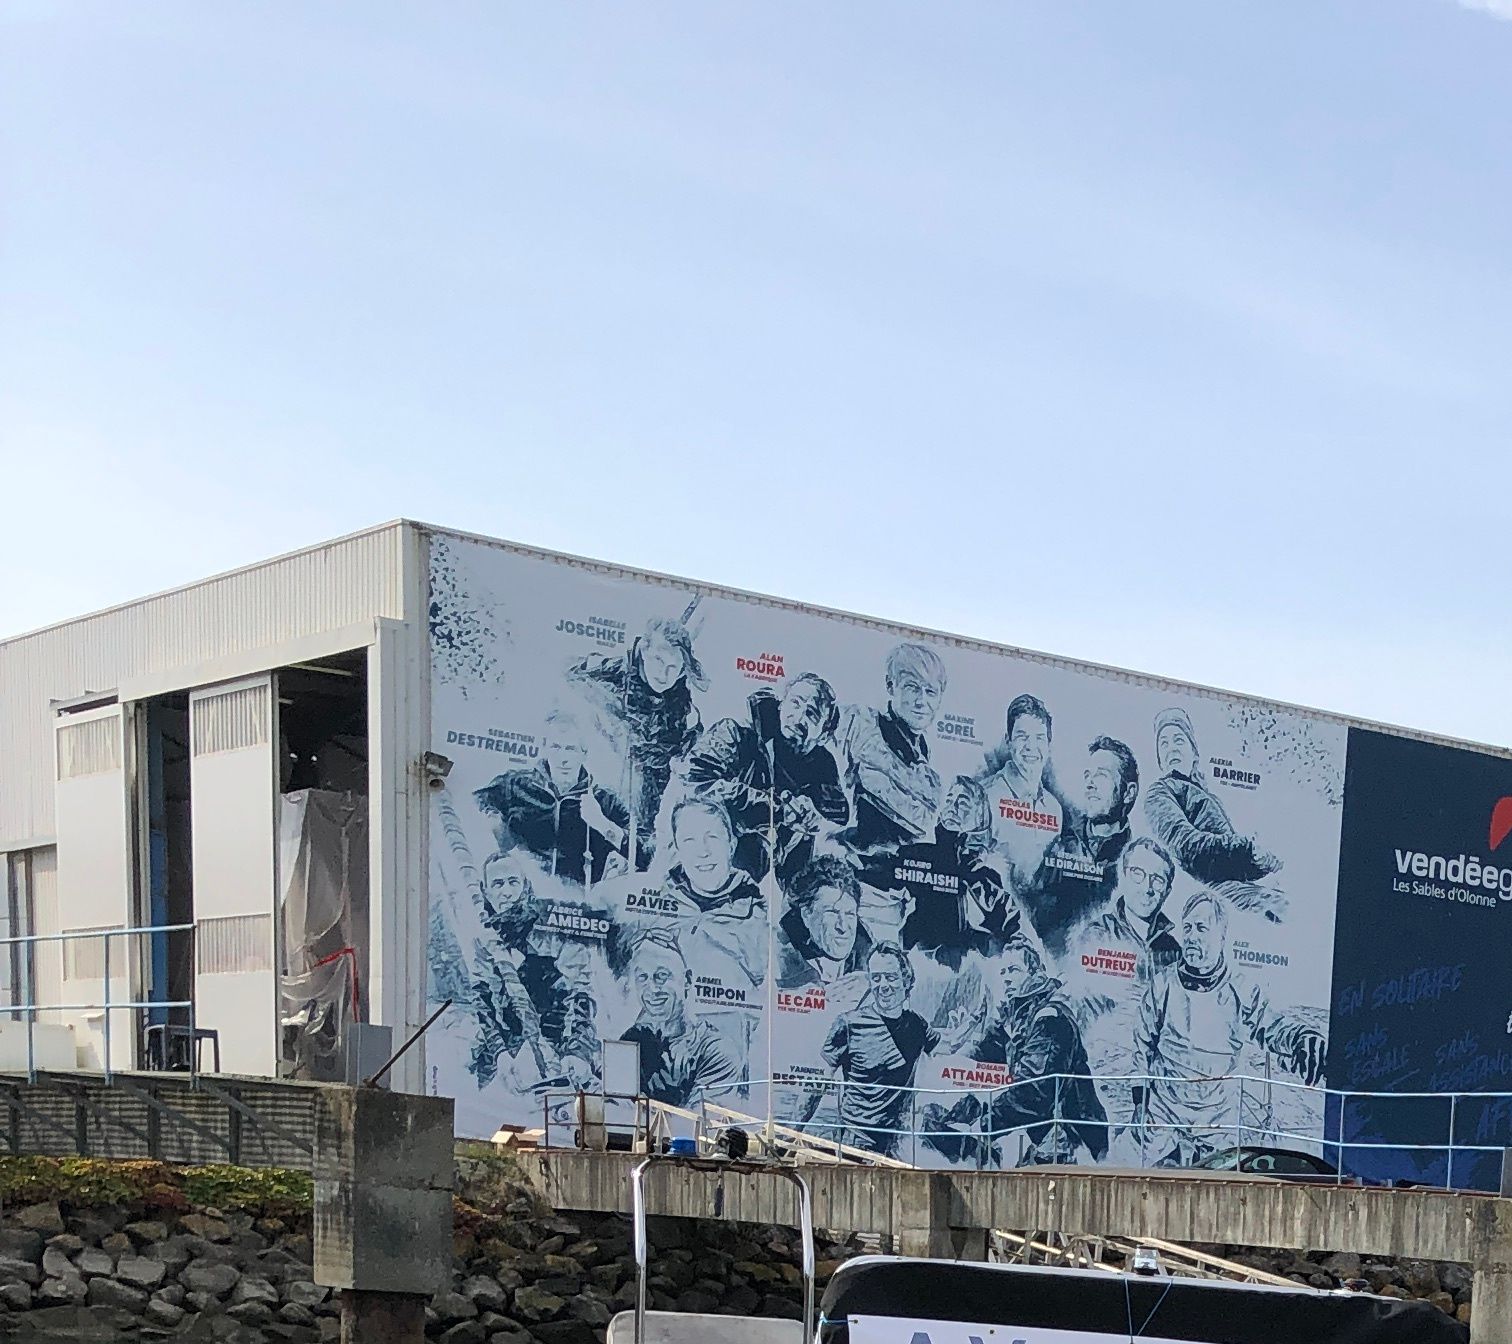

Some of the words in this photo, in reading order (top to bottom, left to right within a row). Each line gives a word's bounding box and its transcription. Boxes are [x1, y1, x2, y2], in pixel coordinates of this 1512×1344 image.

[555, 619, 625, 644] JOSCHKE
[736, 657, 786, 678] ROURA
[760, 653, 784, 663] ALAN
[937, 720, 976, 739] SOREL
[447, 730, 539, 758] DESTREMAU
[1209, 757, 1233, 767] ALEXIA
[1213, 766, 1261, 785] BARRIER
[998, 806, 1059, 828] TROUSSEL
[1044, 856, 1055, 867] LE
[894, 866, 959, 889] SHIRAISHI
[1393, 877, 1410, 893] Les
[1412, 880, 1446, 900] Sables
[1447, 886, 1497, 907] d'Olonne
[626, 893, 679, 913] DAVIES
[546, 912, 611, 934] AMEDEO
[1081, 954, 1136, 973] DUTREUX
[1232, 948, 1289, 967] THOMSON
[695, 984, 746, 1002] TRIPON
[777, 993, 791, 1006] LE
[793, 995, 825, 1011] CAM
[941, 1067, 1015, 1085] ATTANASIO
